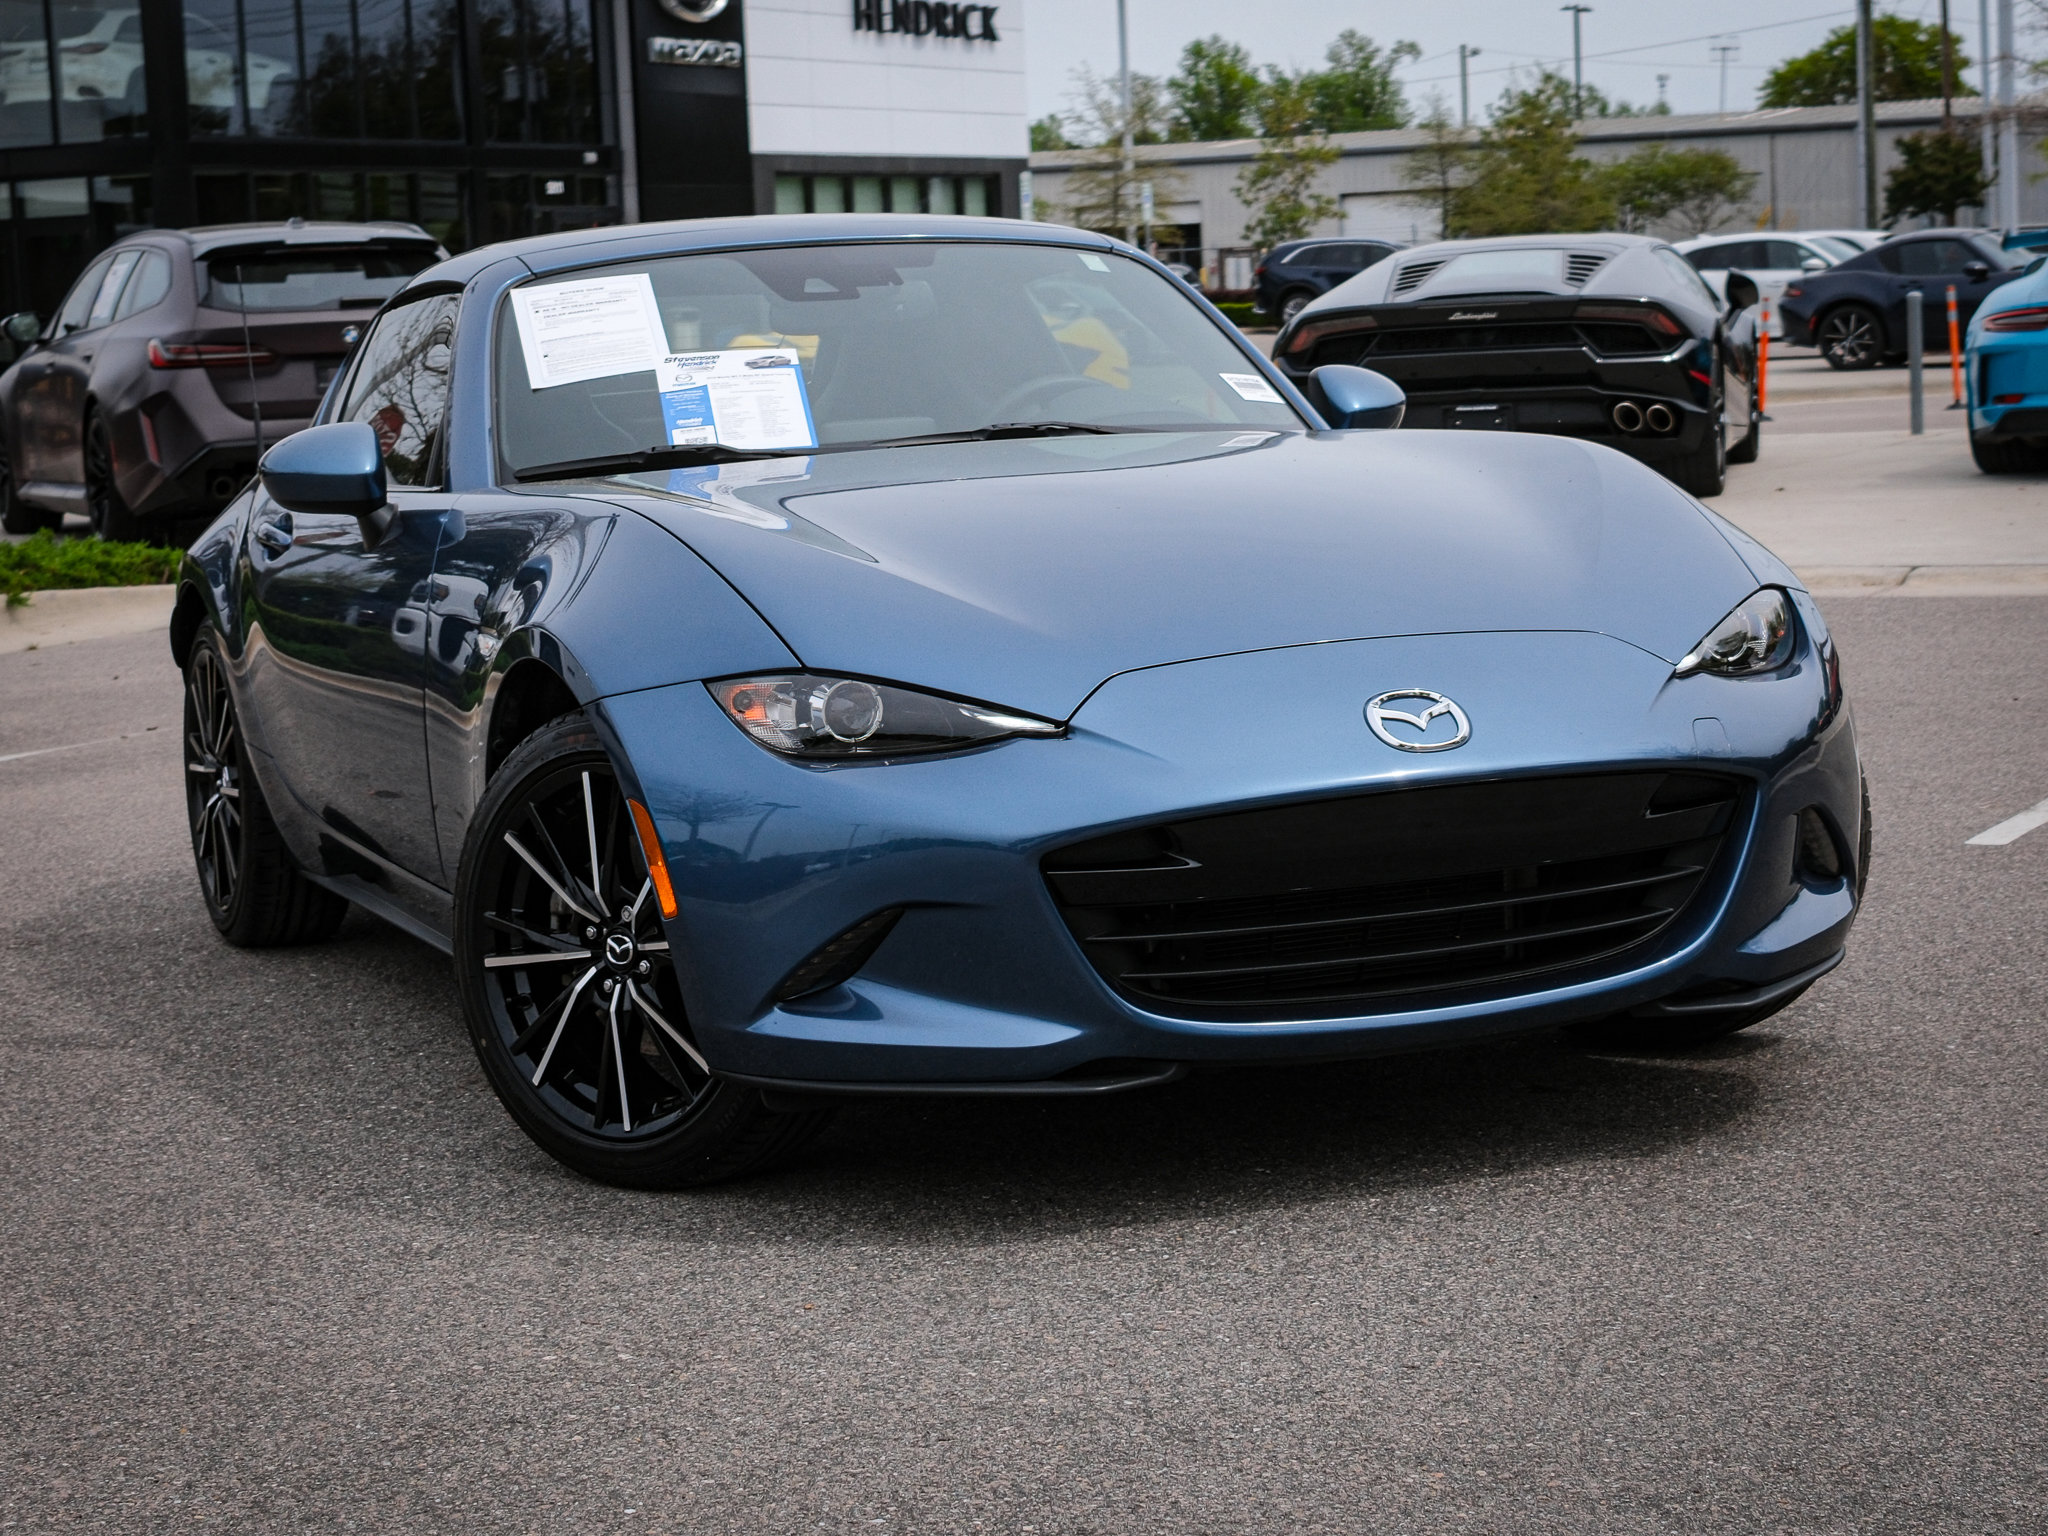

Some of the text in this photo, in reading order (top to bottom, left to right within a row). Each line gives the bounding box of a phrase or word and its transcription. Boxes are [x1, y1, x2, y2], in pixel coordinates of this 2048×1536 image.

[853, 0, 1000, 41] HENDRICK
[663, 355, 720, 364] Stevenson
[677, 360, 717, 369] Hendrick
